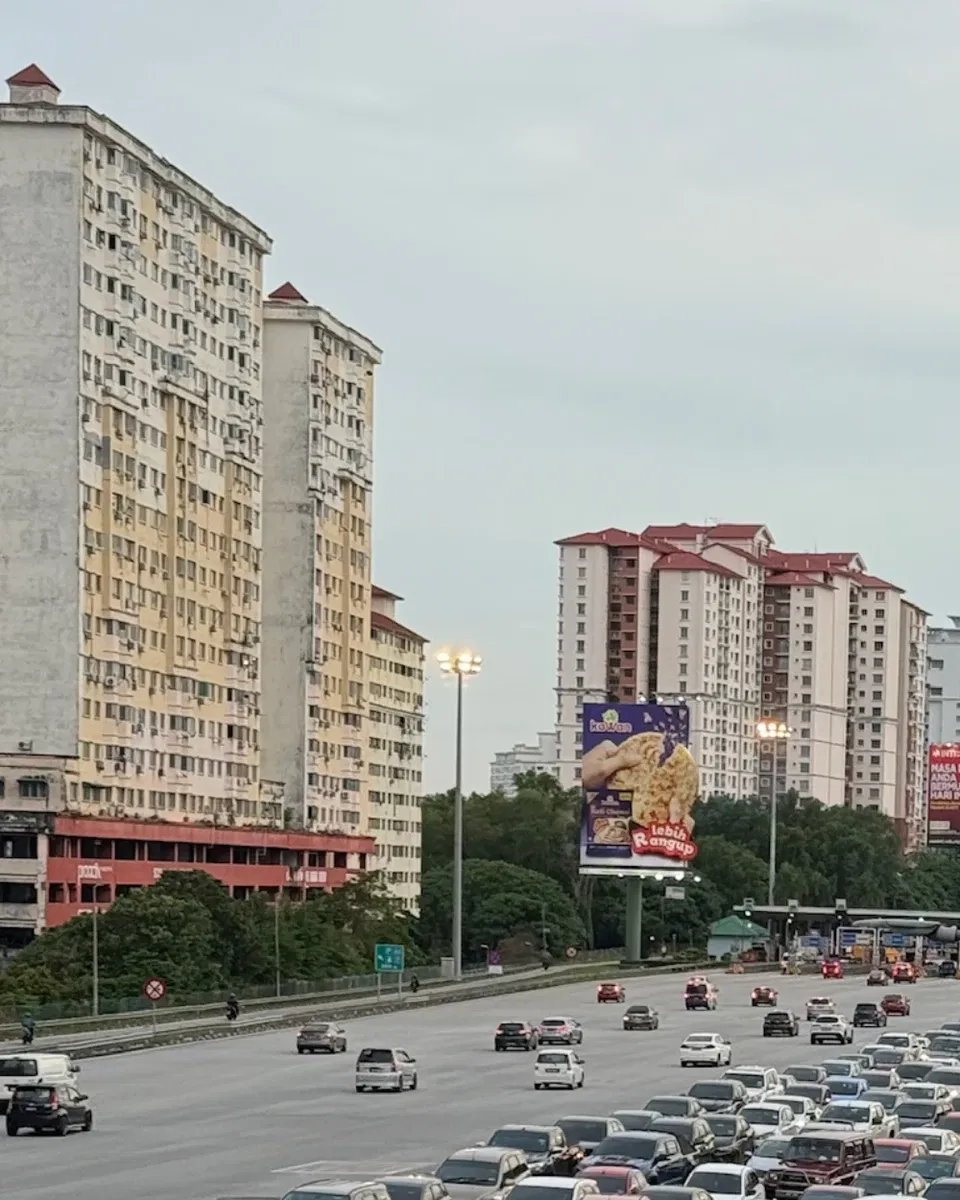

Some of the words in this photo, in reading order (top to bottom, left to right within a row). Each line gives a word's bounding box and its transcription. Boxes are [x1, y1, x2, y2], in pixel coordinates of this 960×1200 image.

[590, 719, 632, 732] kawan
[931, 763, 956, 773] MASA
[931, 773, 957, 782] ANDA
[930, 791, 952, 800] HARI
[651, 824, 687, 841] lebih
